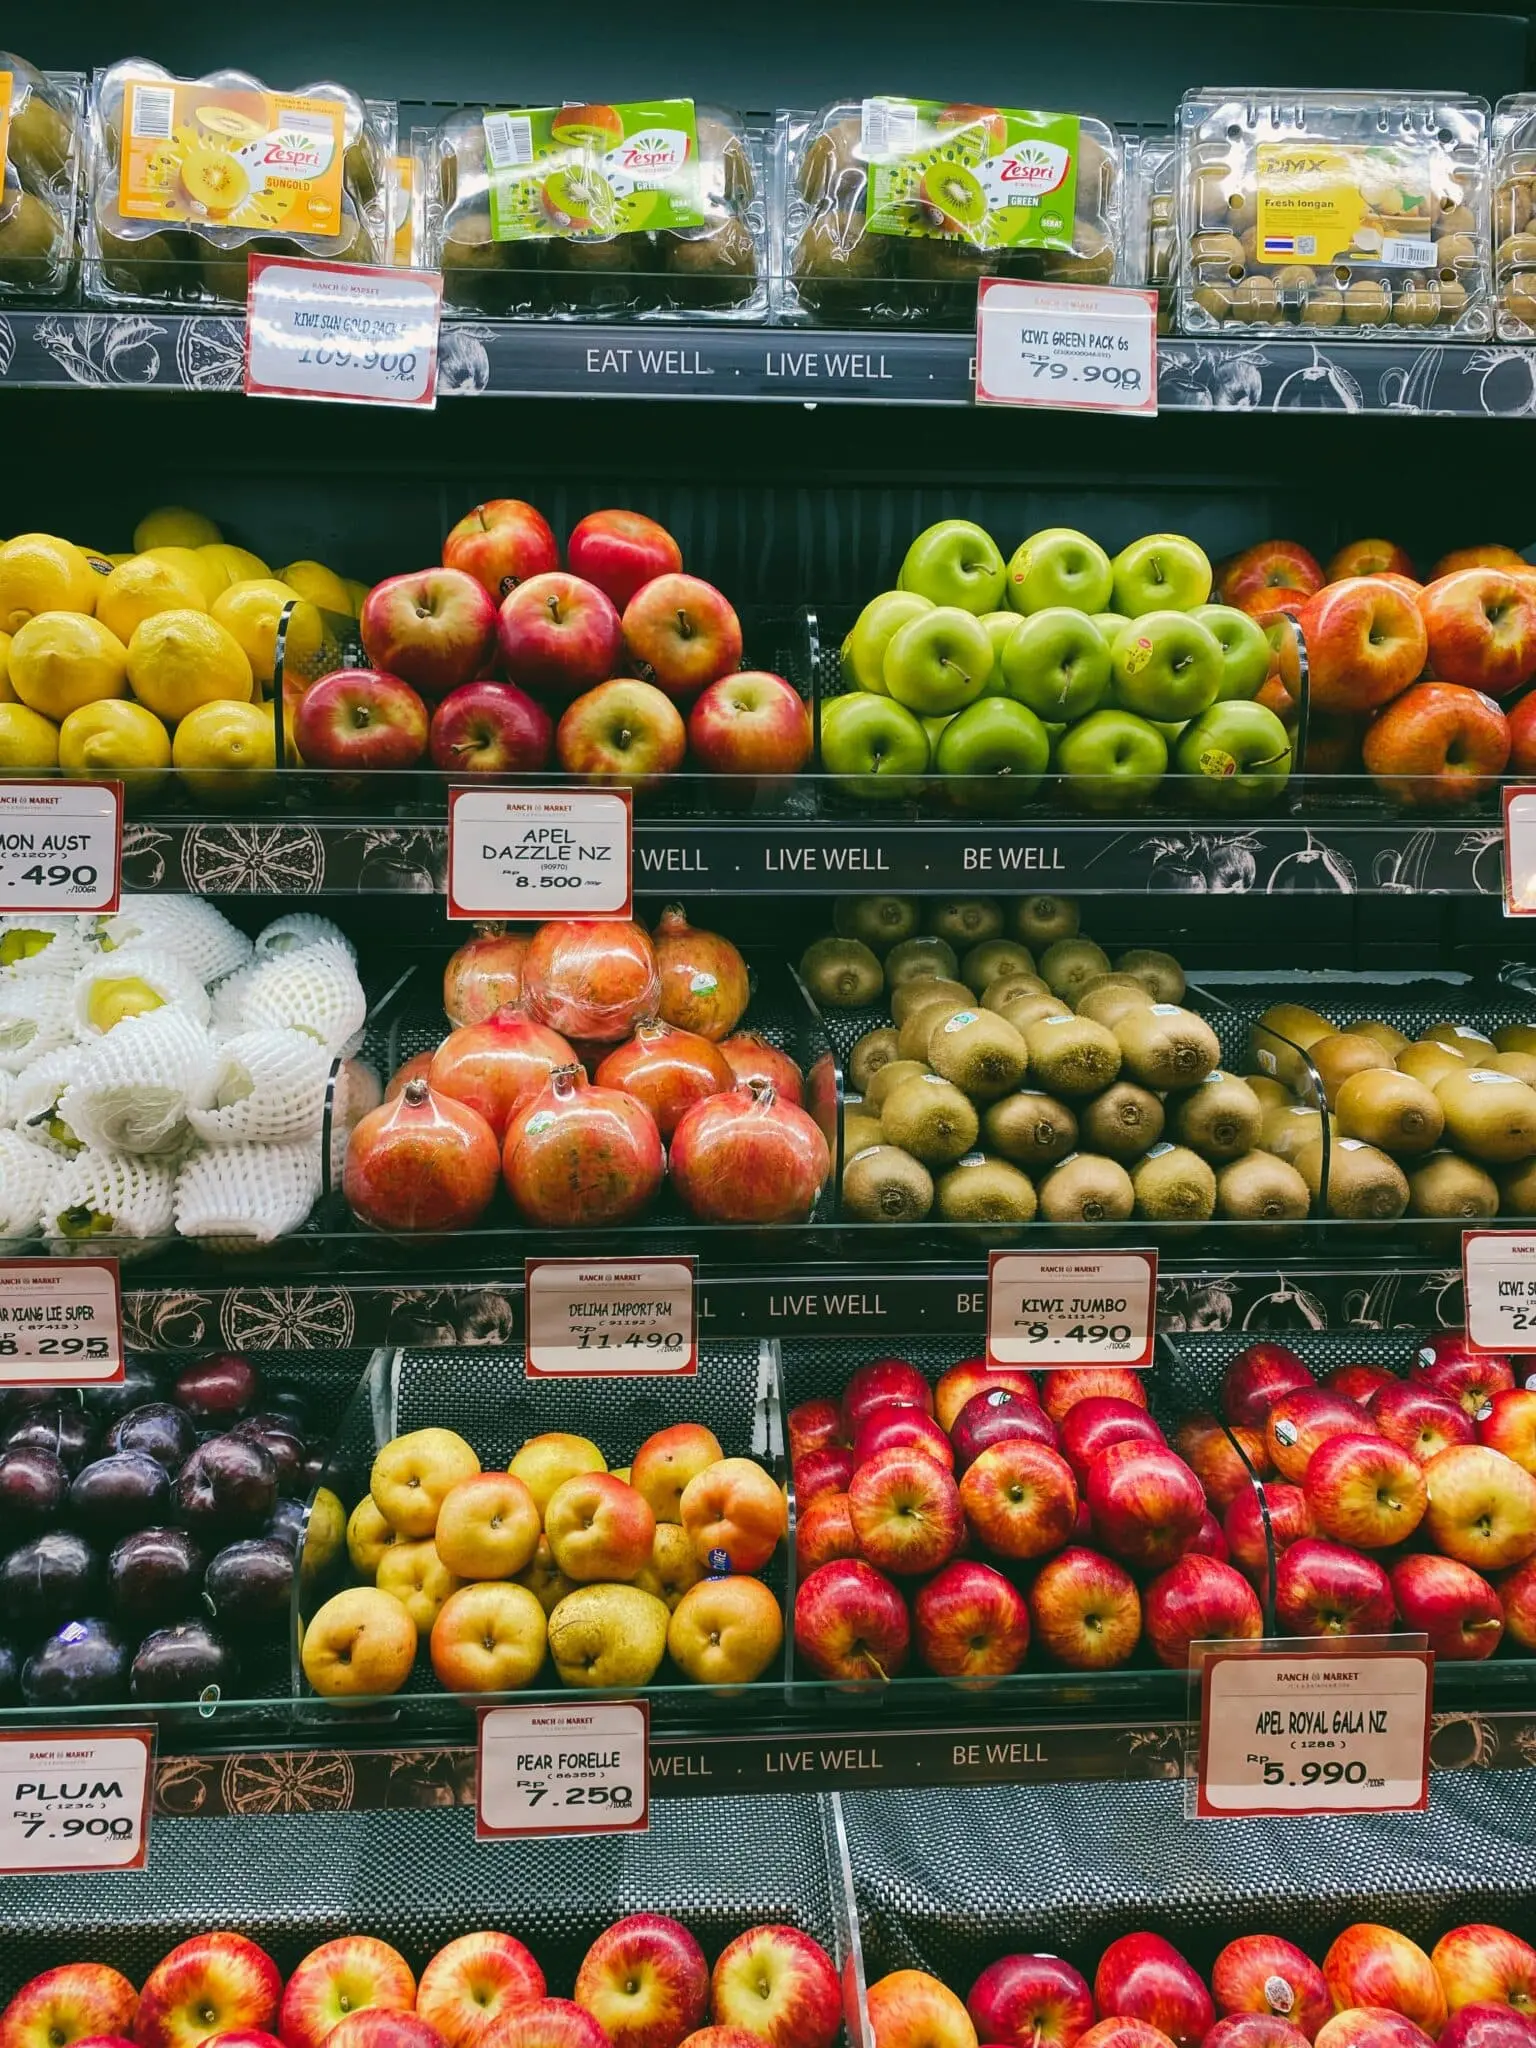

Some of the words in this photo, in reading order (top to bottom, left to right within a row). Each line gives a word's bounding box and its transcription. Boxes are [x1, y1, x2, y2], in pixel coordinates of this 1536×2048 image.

[264, 142, 320, 166] Zespri
[622, 150, 675, 168] Zespri
[1000, 160, 1054, 181] Zespri
[267, 177, 310, 191] SUNGOLD
[1011, 196, 1039, 206] GREEN
[1265, 199, 1295, 208] Fresh
[1297, 199, 1334, 210] longan
[294, 311, 319, 328] KIWI
[321, 314, 340, 329] SUN
[1021, 329, 1049, 346] KIWI
[1052, 331, 1086, 348] GREEN
[1089, 334, 1114, 350] PACK
[1117, 336, 1129, 351] 6s
[586, 349, 633, 373] EAT
[638, 350, 707, 375] WELL
[766, 352, 818, 377] LIVE
[824, 354, 893, 379] WELL
[1030, 361, 1141, 384] 79.900
[29, 797, 59, 805] MARKET
[543, 804, 573, 812] MARKET
[42, 835, 91, 850] AUST
[522, 828, 577, 844] APEL
[482, 845, 571, 861] DAZZLE
[579, 846, 612, 861] NZ
[639, 849, 709, 871] WELL
[765, 848, 817, 871] LIVE
[822, 848, 890, 871] WELL
[963, 847, 992, 870] BE
[998, 847, 1065, 870] WELL
[0, 865, 98, 887] .490
[541, 863, 568, 871] (90970)
[515, 876, 582, 888] 8.500
[32, 1277, 61, 1285] MARKET
[1499, 1281, 1523, 1296] KIWI
[569, 1303, 609, 1317] DELIMA
[611, 1301, 654, 1316] IMPORT
[656, 1302, 672, 1316] RM
[770, 1296, 817, 1316] LIVE
[824, 1295, 887, 1315] WELL
[957, 1293, 984, 1313] BE
[1022, 1299, 1063, 1313] KIWI
[1070, 1299, 1126, 1312] JUMBO
[12, 1306, 43, 1321] XIANG
[46, 1305, 62, 1320] LIE
[65, 1305, 95, 1320] SUPER
[577, 1333, 683, 1349] 11.490
[1028, 1325, 1131, 1343] 9.490
[1277, 1673, 1309, 1682] RANCH
[1323, 1672, 1359, 1681] MARKET
[532, 1718, 556, 1726] RANCH
[566, 1717, 593, 1725] MARKET
[1256, 1711, 1285, 1735] APEL
[1288, 1711, 1328, 1735] ROYAL
[1332, 1711, 1364, 1734] GALA
[1368, 1710, 1388, 1733] NZ
[517, 1754, 552, 1771] PEAR
[558, 1752, 620, 1769] FORELLE
[766, 1752, 814, 1773] LIVE
[819, 1749, 884, 1770] WELL
[952, 1745, 981, 1766] BE
[984, 1743, 1049, 1764] WELL
[649, 1756, 713, 1777] WELL
[1247, 1754, 1270, 1765] Rp
[1263, 1761, 1367, 1786] 5.990
[15, 1781, 123, 1801] PLUM
[517, 1780, 545, 1789] Rp
[525, 1786, 633, 1807] 7.250
[13, 1811, 43, 1819] Rp
[21, 1817, 133, 1838] 7.900
